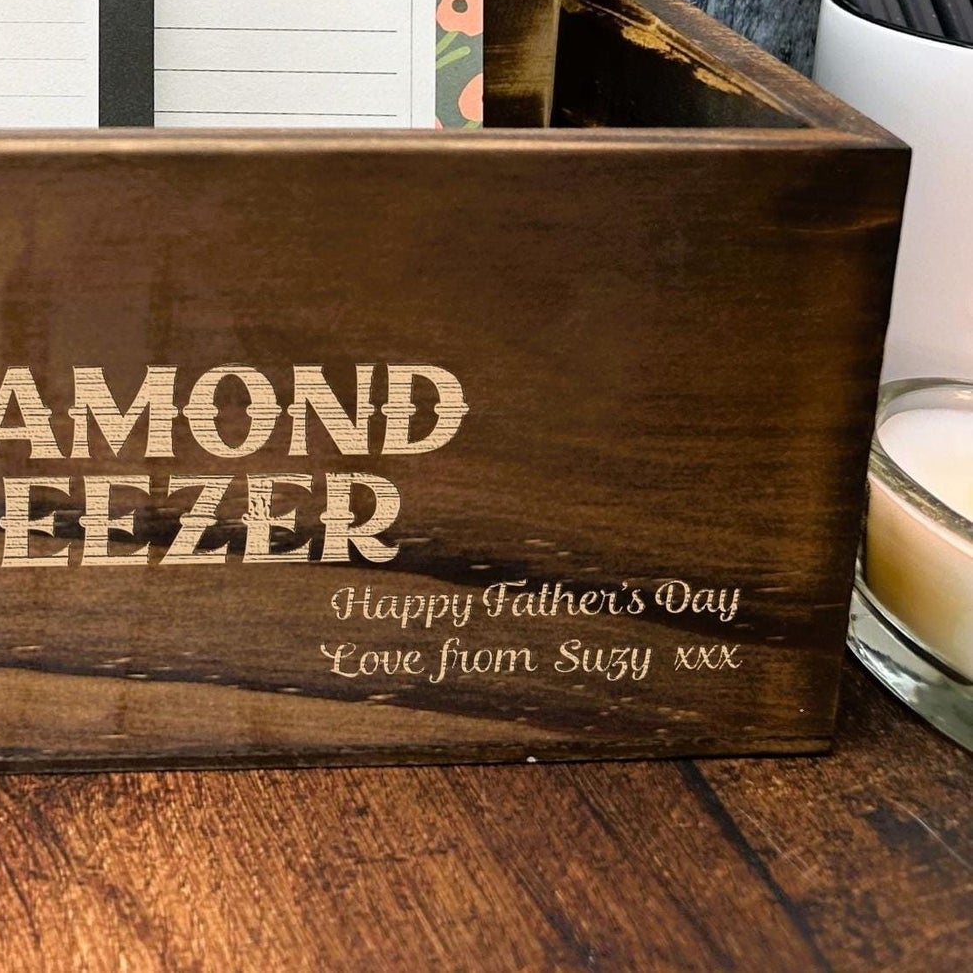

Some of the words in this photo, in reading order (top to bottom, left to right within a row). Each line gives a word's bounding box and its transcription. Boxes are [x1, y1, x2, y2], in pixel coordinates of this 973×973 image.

[330, 585, 473, 629] Happy
[482, 578, 647, 618] Father's
[654, 579, 741, 623] Day
[320, 642, 426, 679] Love
[428, 637, 539, 684] from
[553, 638, 653, 683] Suzy
[674, 643, 743, 670] xxx
